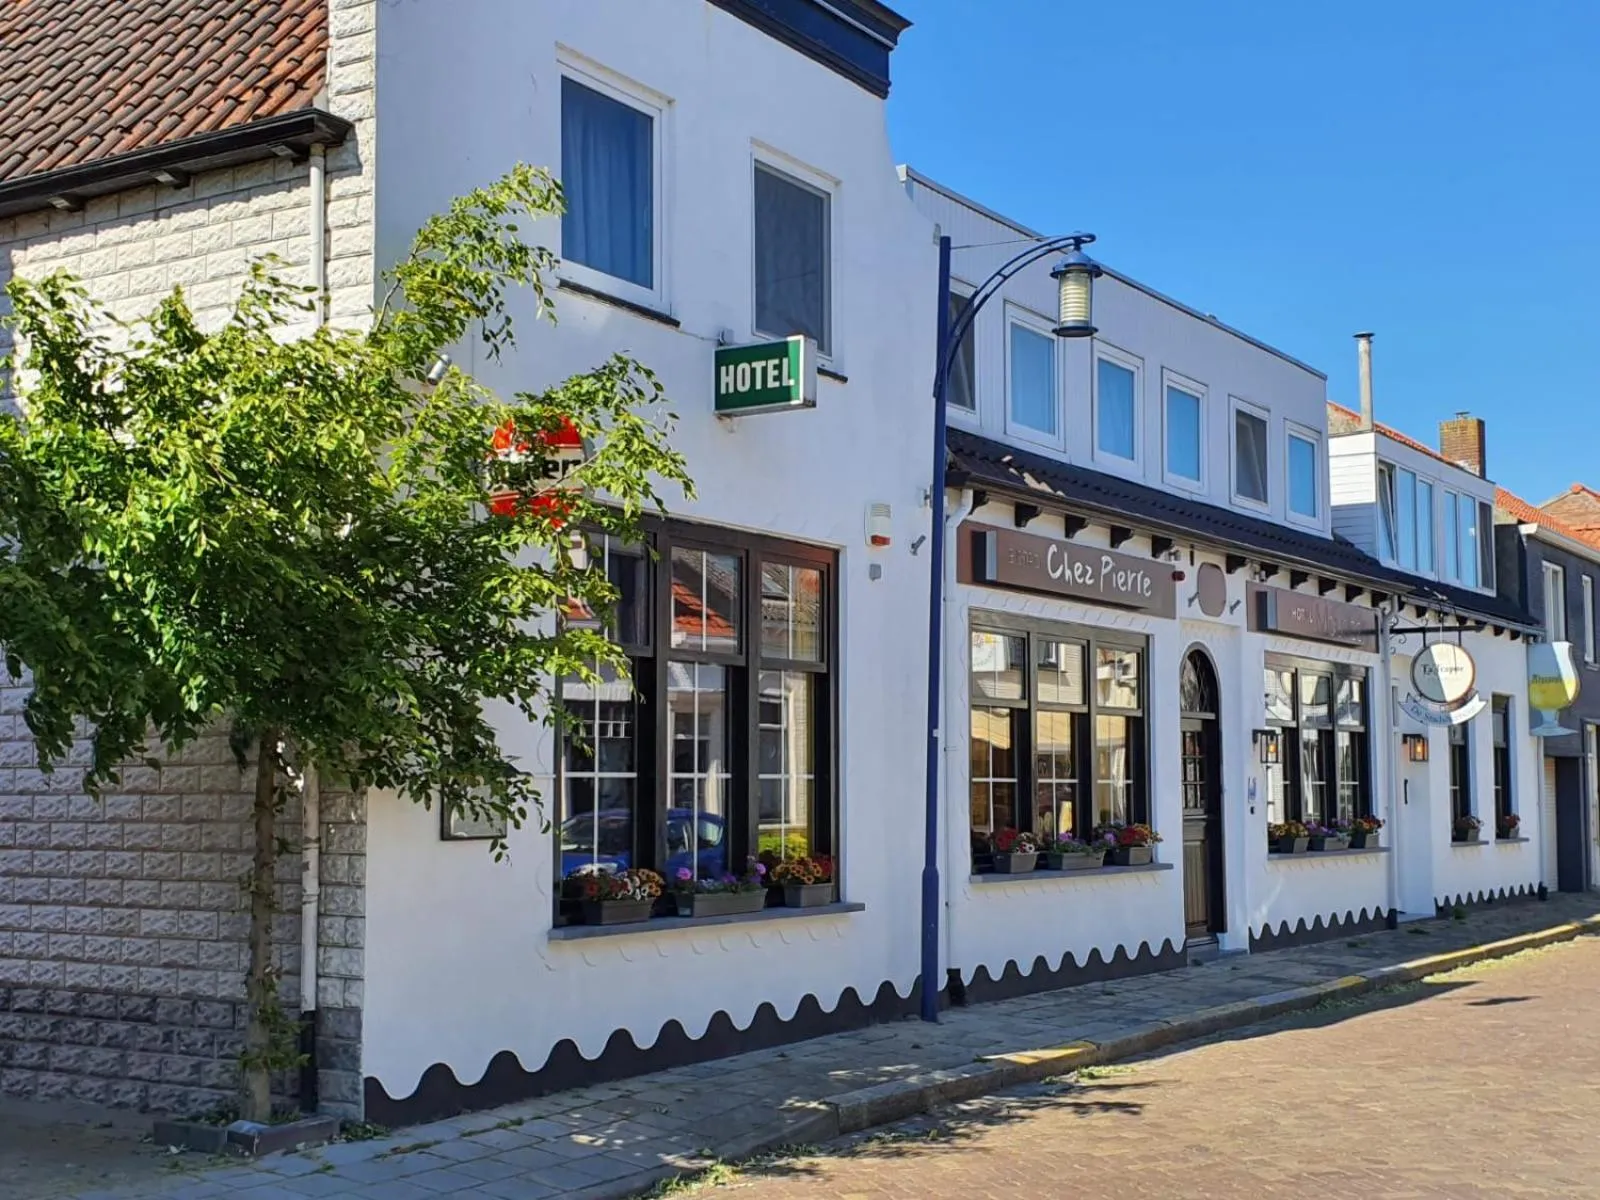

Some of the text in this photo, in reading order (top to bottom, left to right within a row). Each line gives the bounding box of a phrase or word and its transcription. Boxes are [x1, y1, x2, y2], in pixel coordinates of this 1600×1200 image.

[720, 357, 795, 395] HOTEL
[1047, 543, 1095, 587] Chez
[1100, 555, 1152, 597] Pierre
